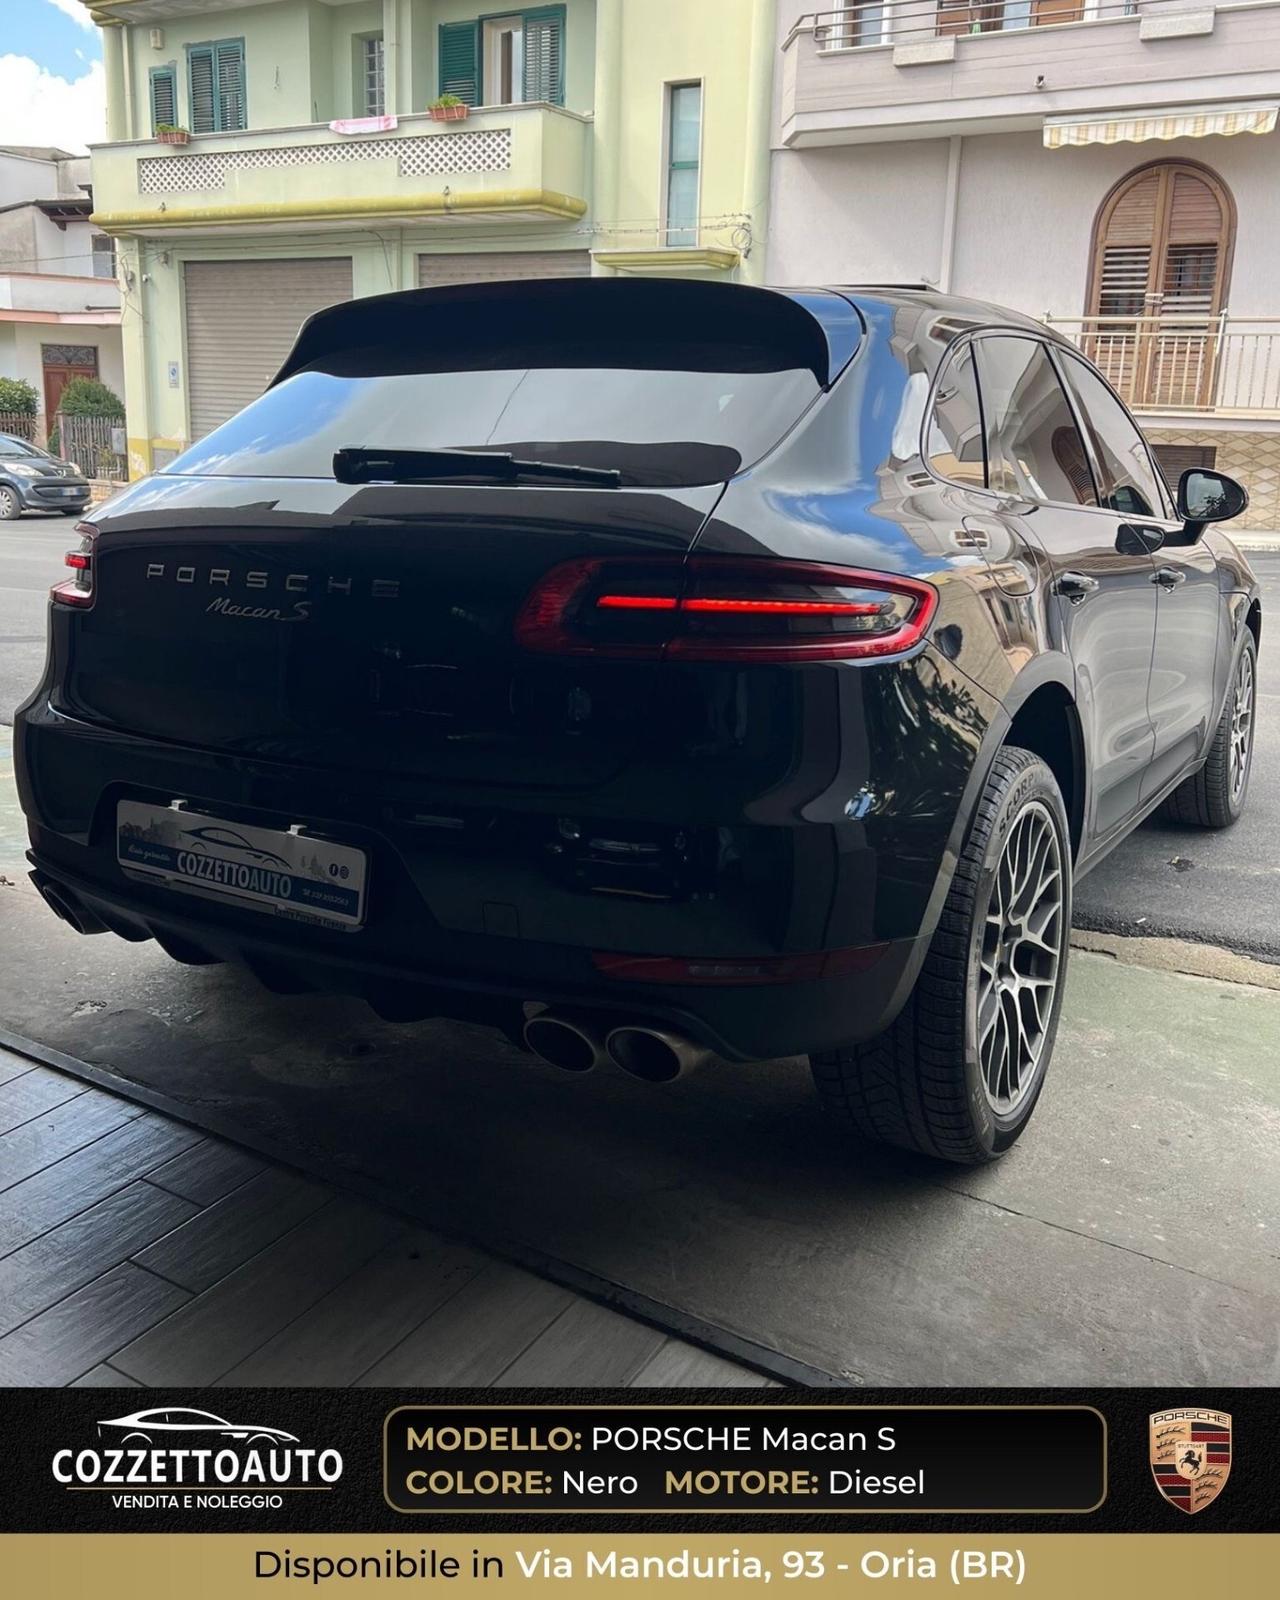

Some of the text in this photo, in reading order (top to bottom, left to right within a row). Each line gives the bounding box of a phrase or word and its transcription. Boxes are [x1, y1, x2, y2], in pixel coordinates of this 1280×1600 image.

[146, 563, 401, 598] PORSCHE
[206, 597, 313, 621] Macan S
[177, 851, 292, 898] COZZETTOAUTO
